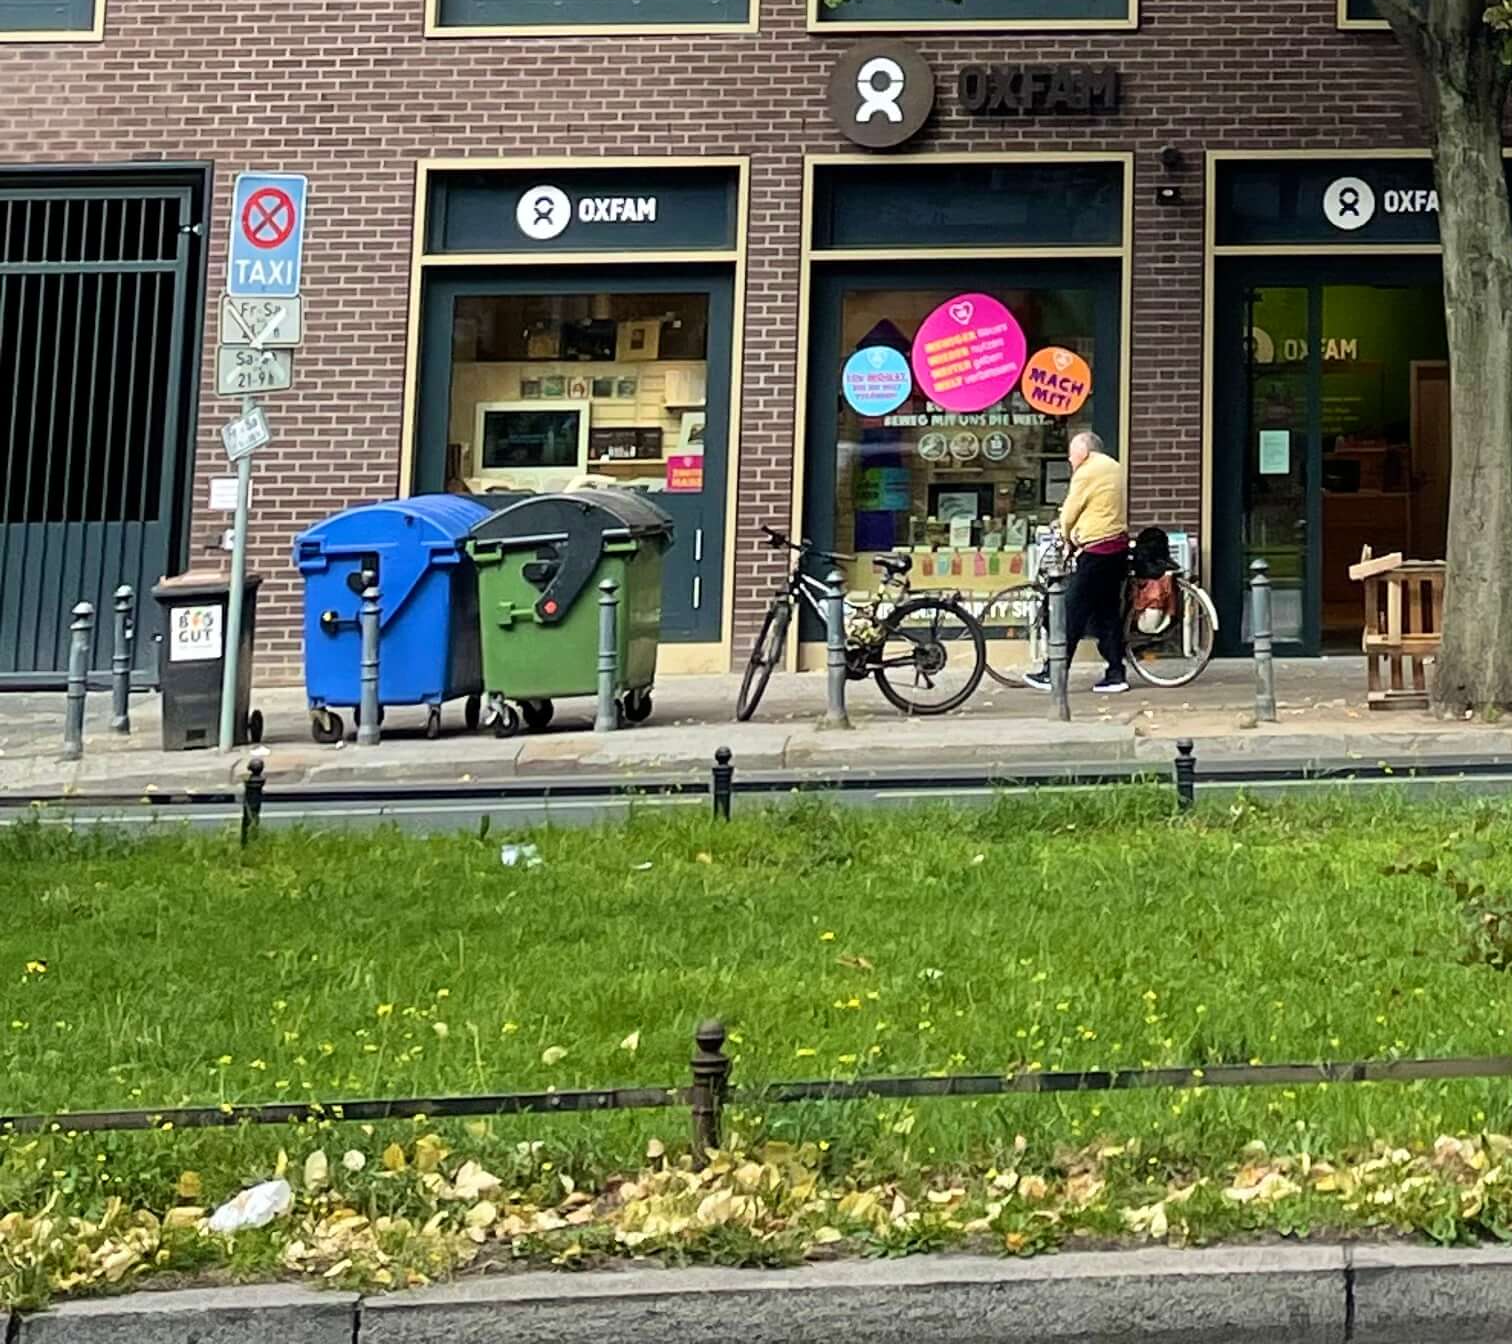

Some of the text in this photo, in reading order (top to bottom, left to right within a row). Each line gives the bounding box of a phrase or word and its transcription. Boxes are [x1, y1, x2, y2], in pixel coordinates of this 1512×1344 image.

[959, 65, 1118, 111] OXFAM
[578, 197, 657, 222] OXFAM
[1384, 190, 1440, 212] OXFA
[235, 259, 294, 285] TAXI
[1284, 338, 1357, 361] OXAM
[1029, 368, 1084, 396] MACH
[1032, 386, 1071, 411] MIT!
[179, 629, 214, 643] GUT
